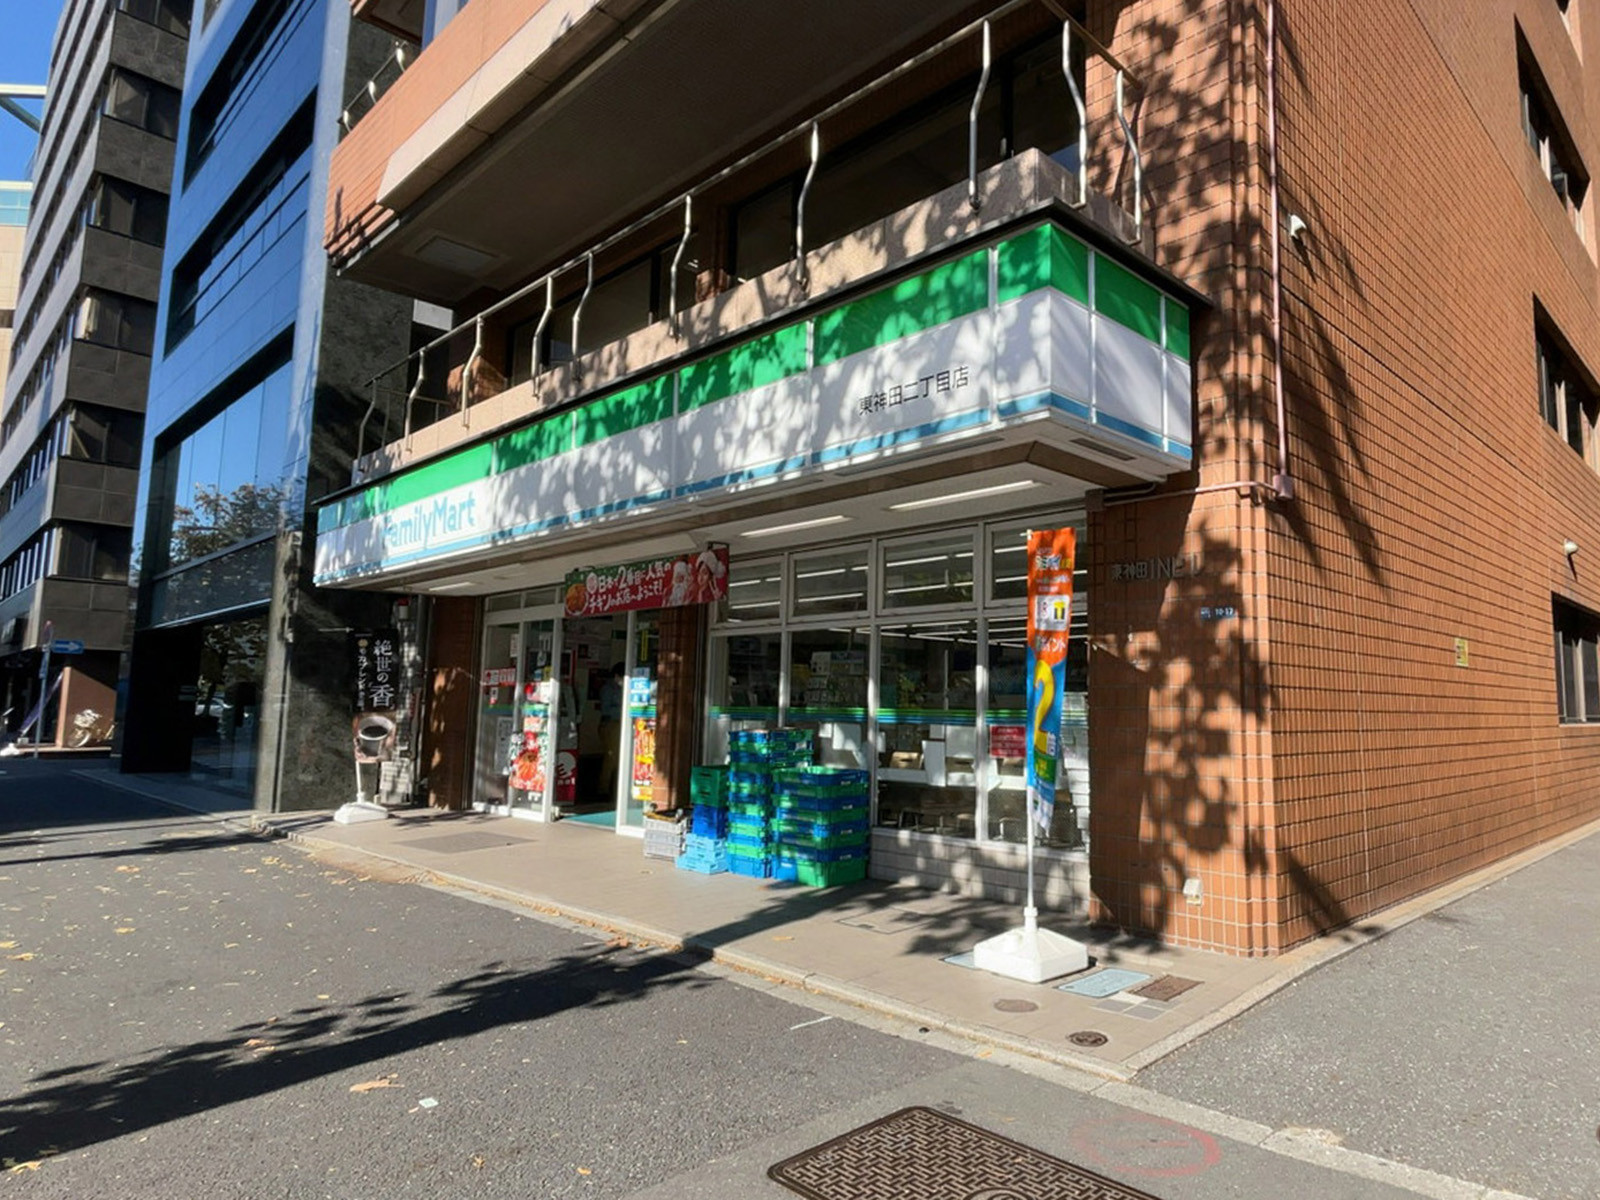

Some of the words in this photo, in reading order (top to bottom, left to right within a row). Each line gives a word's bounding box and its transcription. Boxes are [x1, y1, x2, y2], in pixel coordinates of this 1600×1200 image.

[859, 366, 968, 416] 東神田二丁目店
[384, 491, 475, 550] FamilyMart
